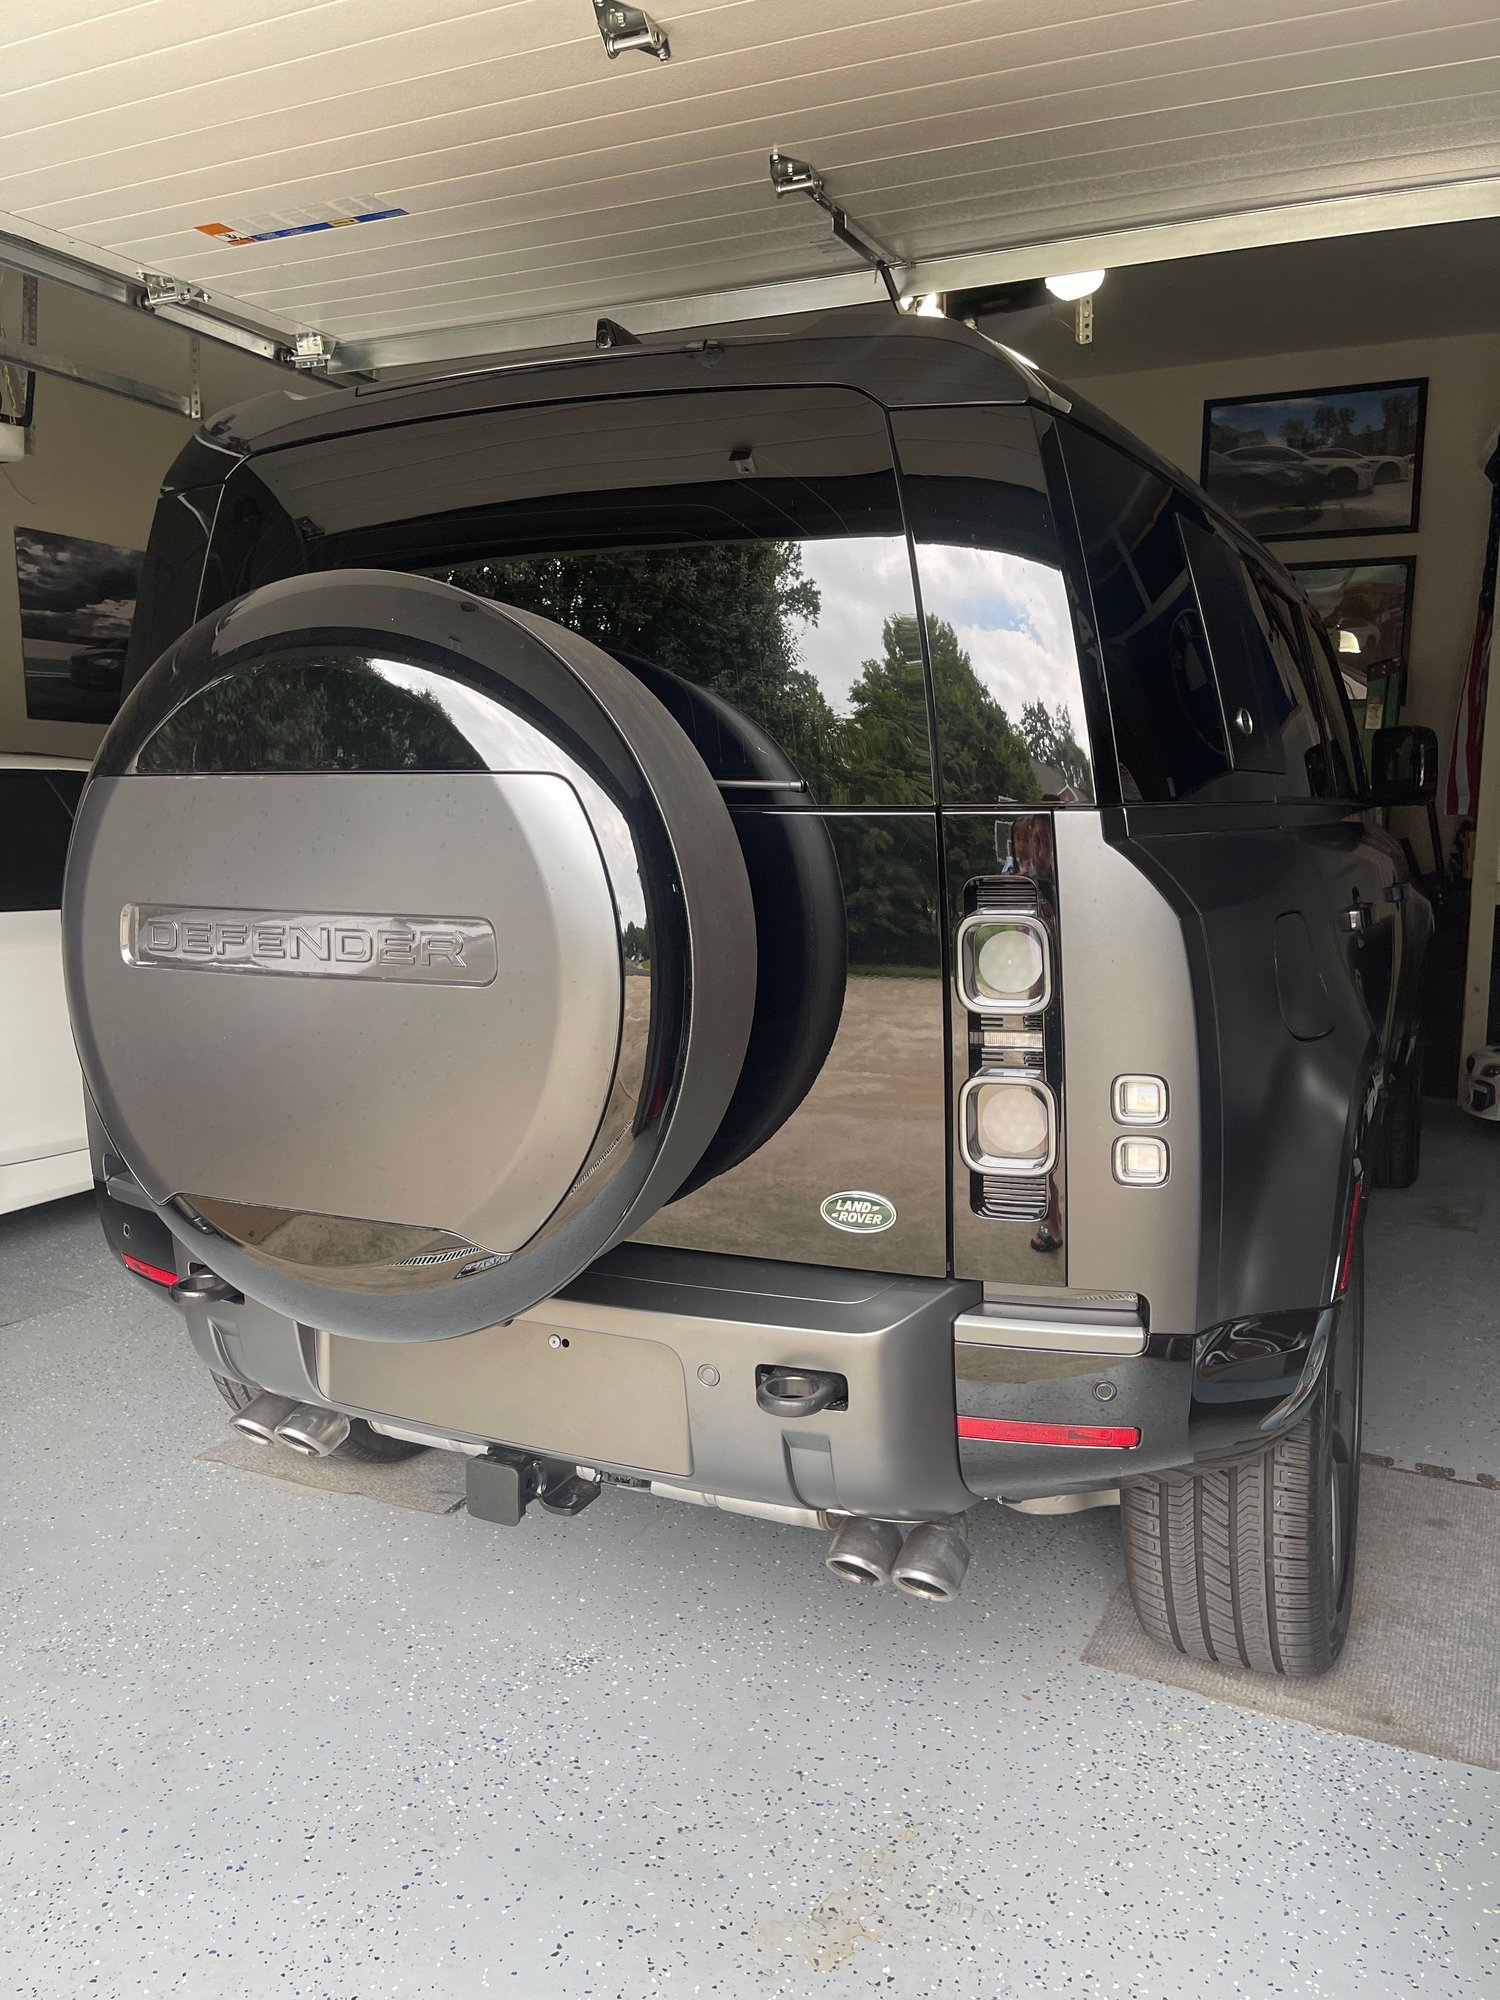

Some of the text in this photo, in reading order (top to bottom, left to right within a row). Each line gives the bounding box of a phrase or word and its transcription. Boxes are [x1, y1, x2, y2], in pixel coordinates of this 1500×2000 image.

[145, 920, 467, 968] DEFENDER
[836, 1200, 871, 1213] LAND
[839, 1211, 882, 1224] ROVER
